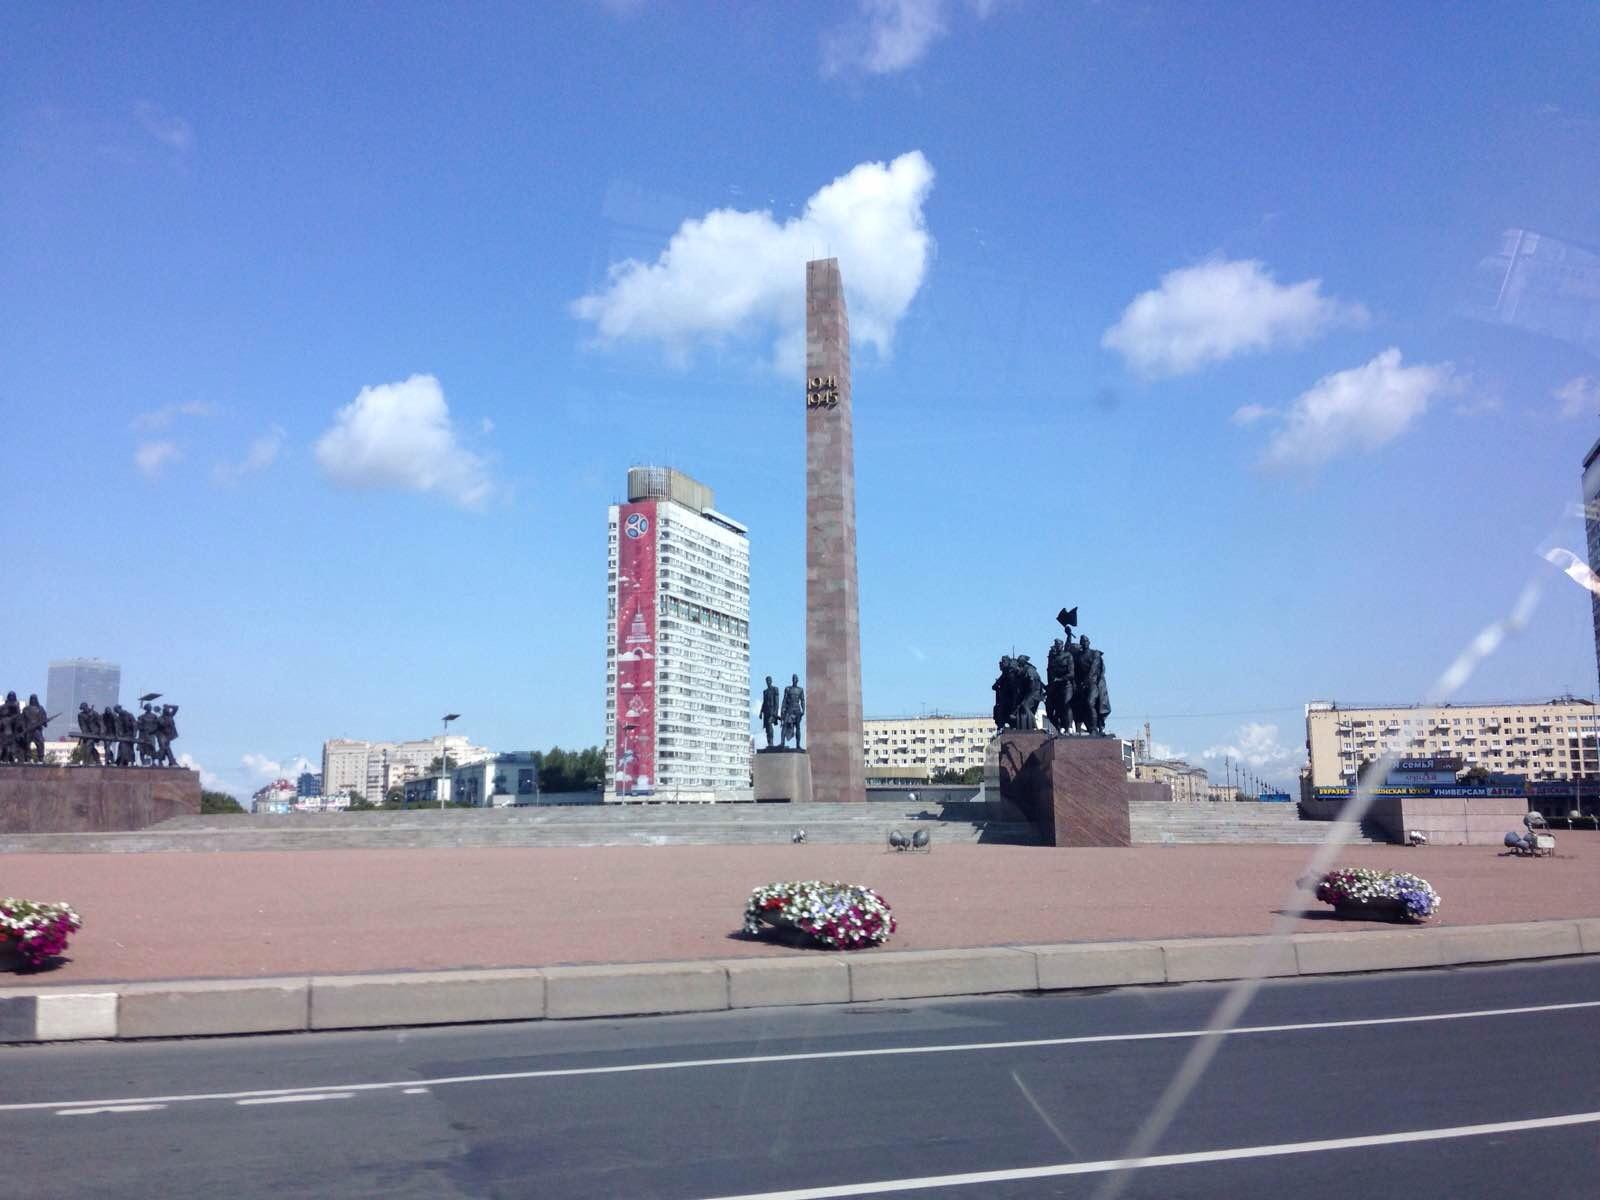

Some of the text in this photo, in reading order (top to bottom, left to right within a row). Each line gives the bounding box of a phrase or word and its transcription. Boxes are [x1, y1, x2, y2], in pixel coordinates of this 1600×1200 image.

[808, 375, 837, 390] 1941
[807, 390, 839, 408] 1945
[1433, 788, 1486, 796] УНИВЕРСАМ
